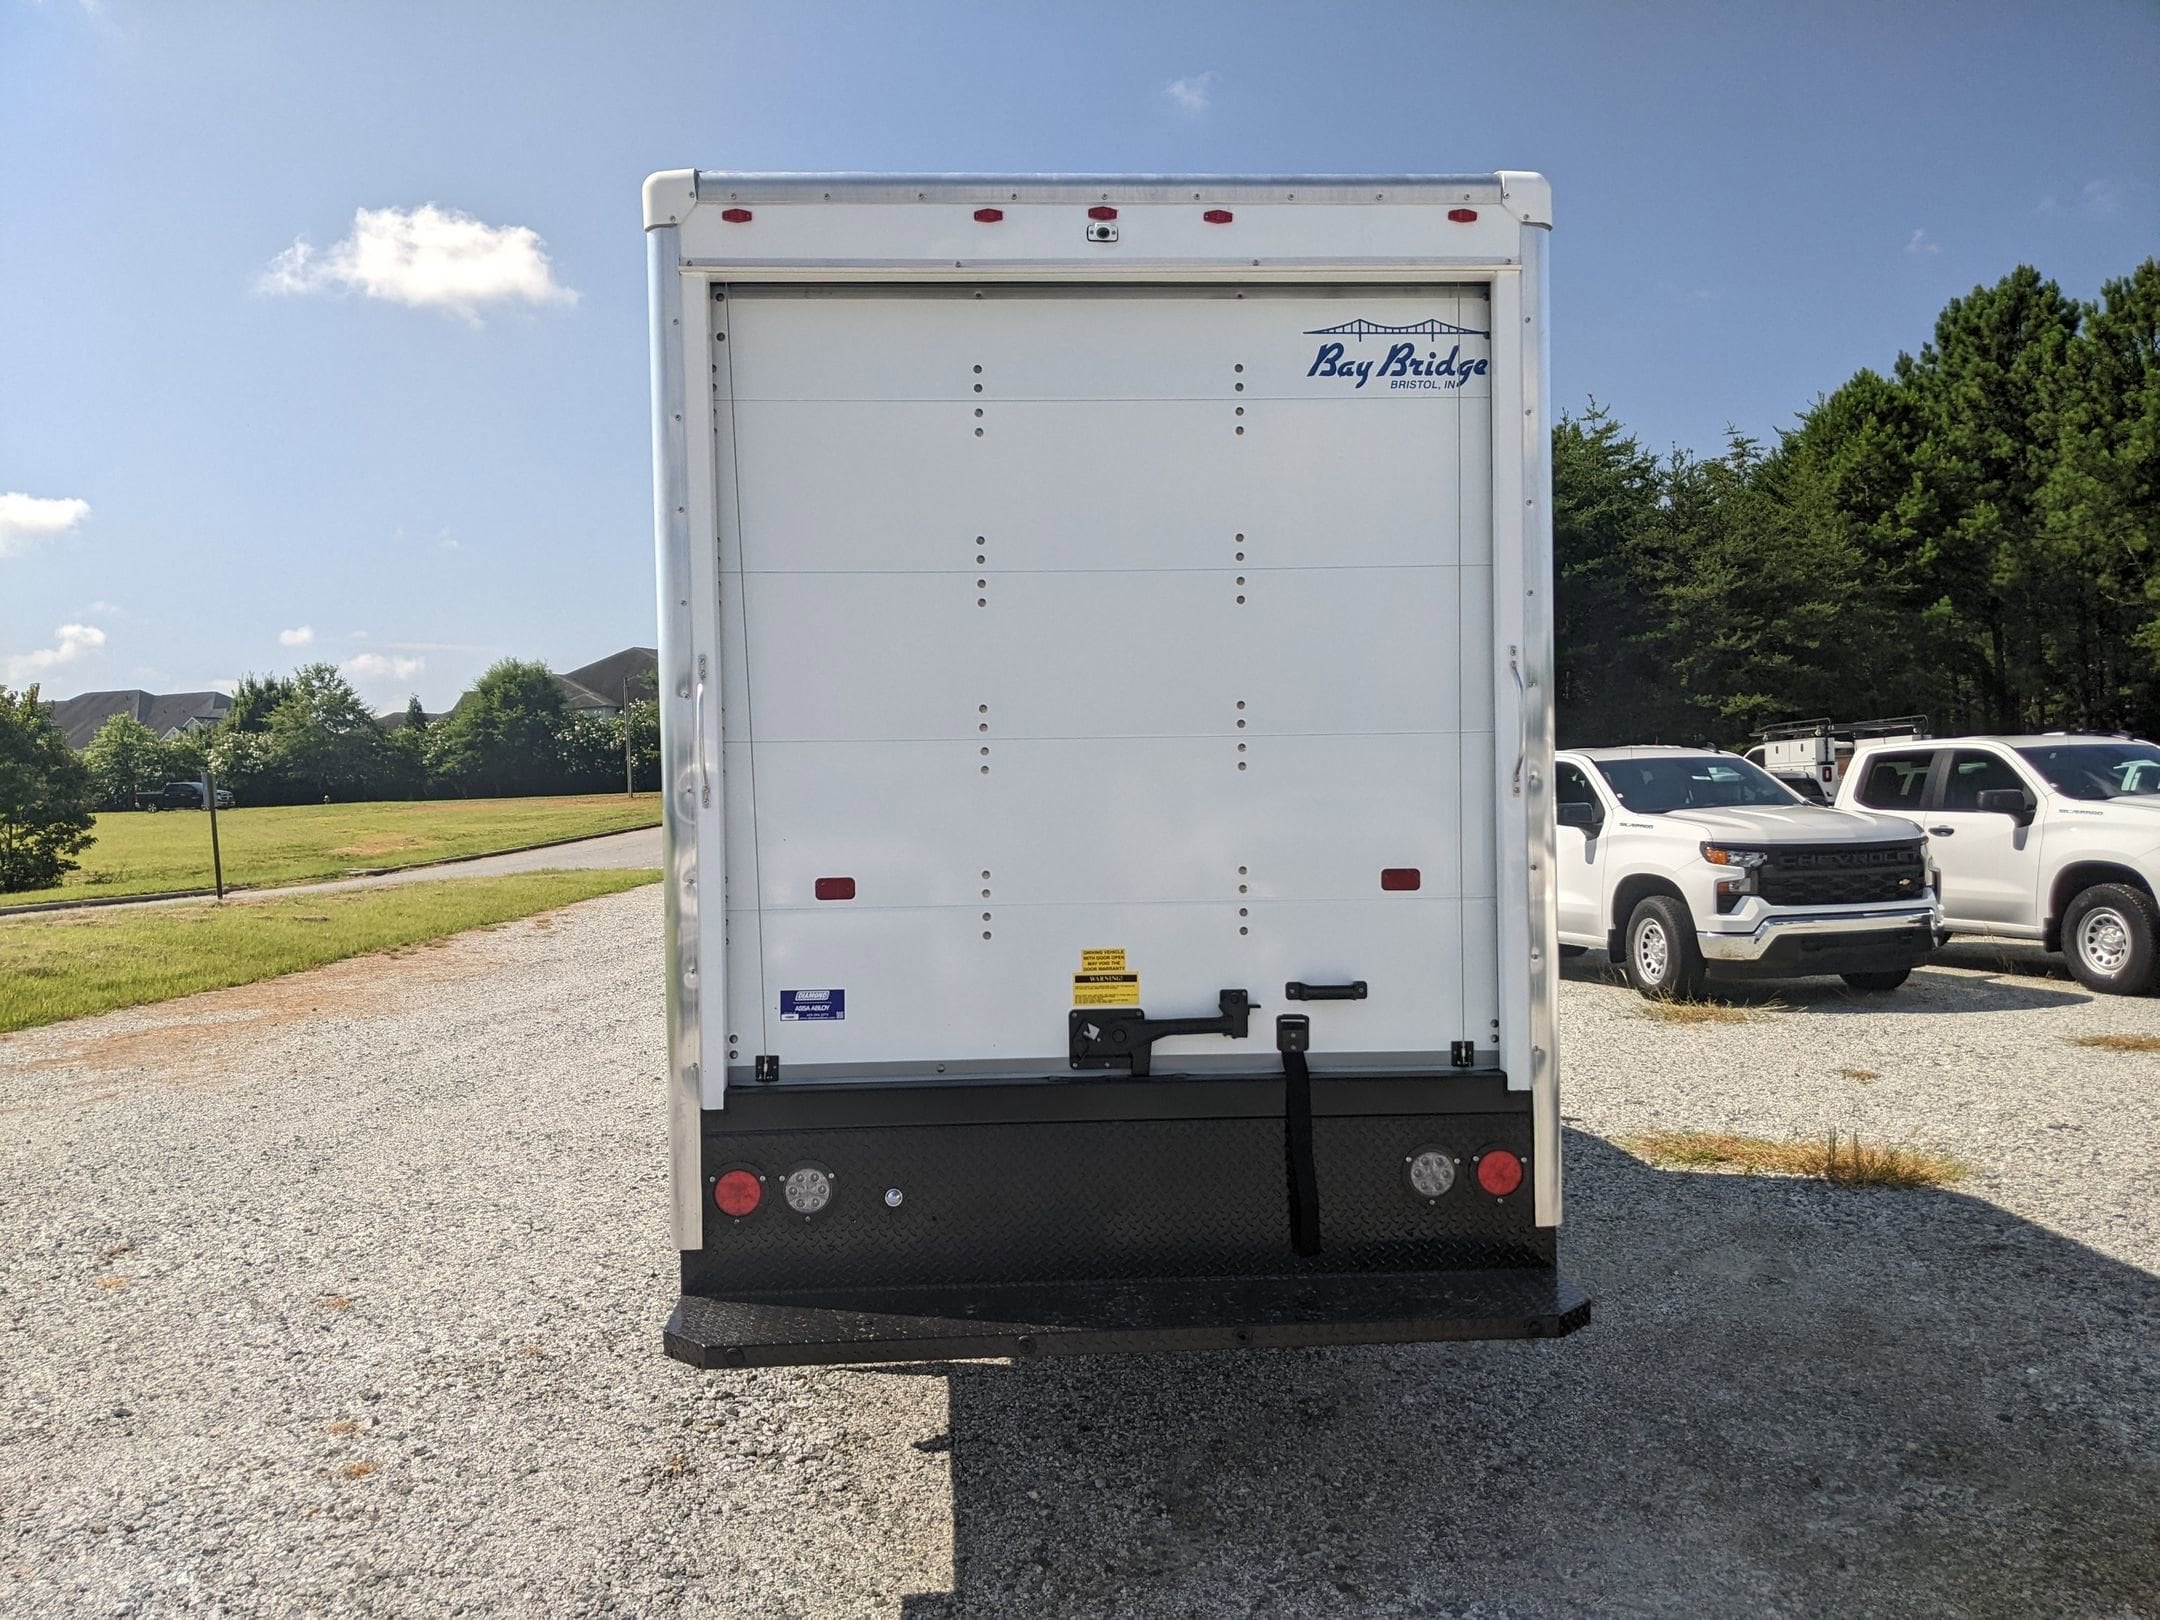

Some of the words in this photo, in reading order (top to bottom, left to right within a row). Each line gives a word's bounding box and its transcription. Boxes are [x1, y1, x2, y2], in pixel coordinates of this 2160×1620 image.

[1306, 342, 1374, 389] Bay
[1376, 342, 1489, 387] Bridge
[1390, 380, 1441, 390] BRISTOL,
[1778, 850, 1919, 866] CHEVROLET
